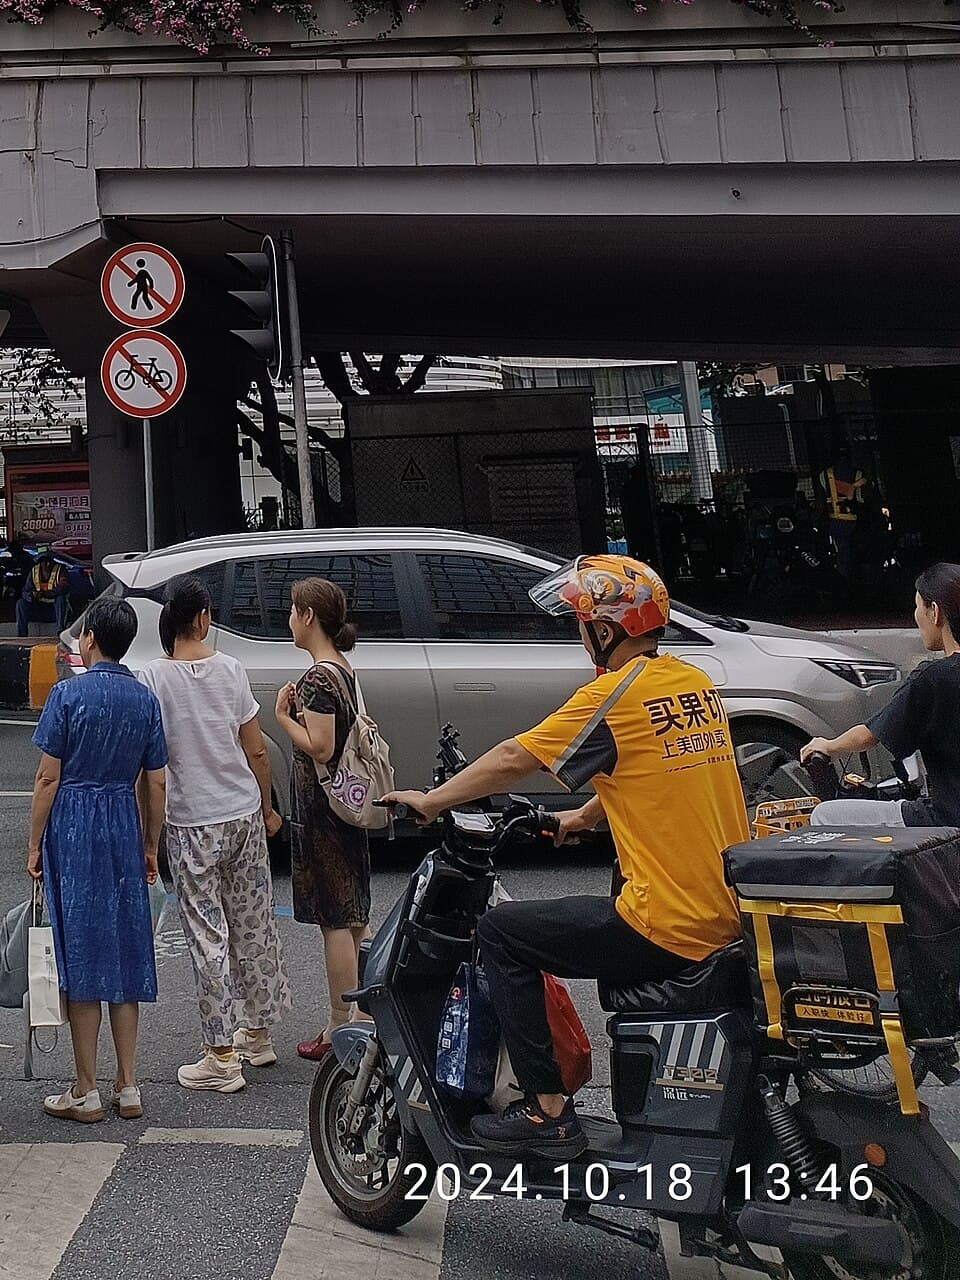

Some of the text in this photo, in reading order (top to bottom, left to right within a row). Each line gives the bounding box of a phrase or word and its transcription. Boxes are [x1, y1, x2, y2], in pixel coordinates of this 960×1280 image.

[642, 688, 728, 737] 买果切
[661, 729, 728, 760] 上美团外卖
